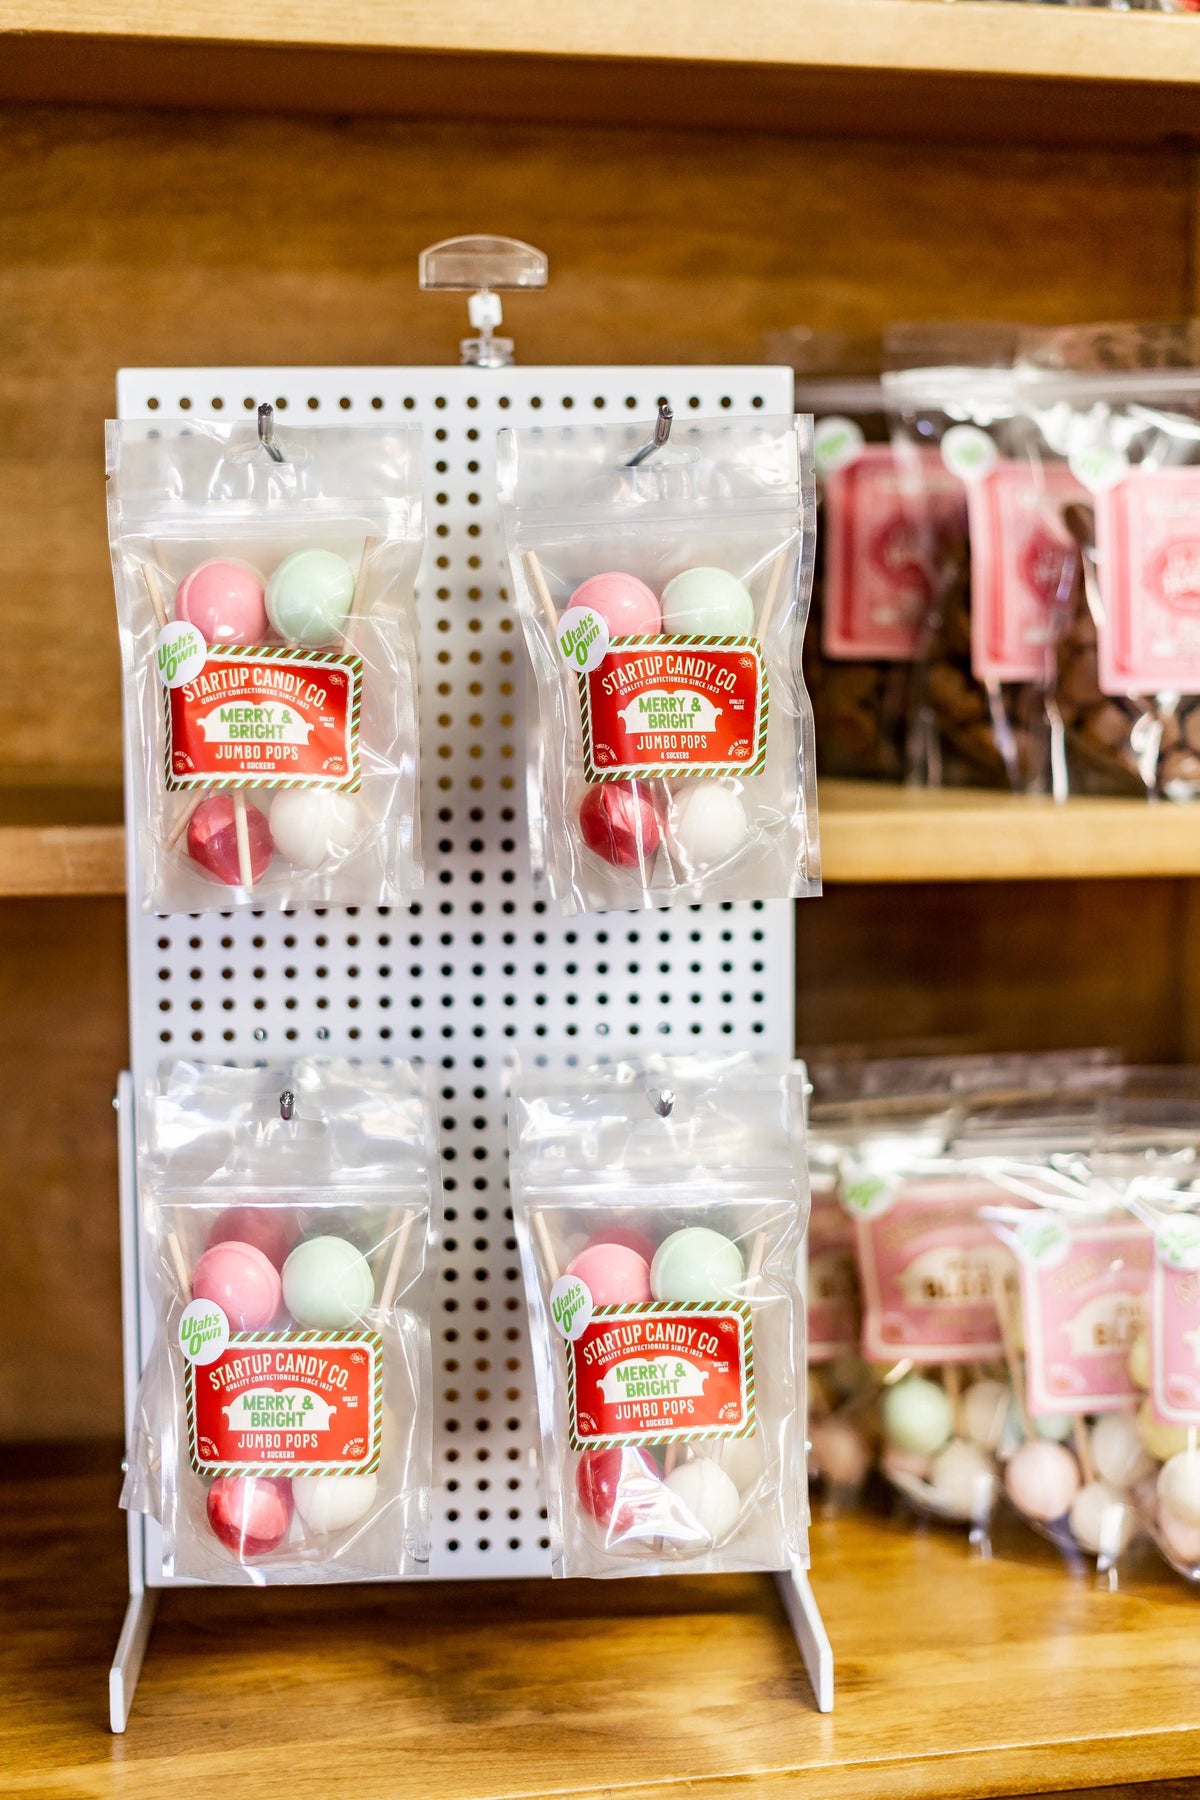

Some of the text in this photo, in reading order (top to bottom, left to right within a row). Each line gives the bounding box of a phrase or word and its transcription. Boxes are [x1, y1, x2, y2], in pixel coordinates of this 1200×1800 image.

[559, 612, 594, 657] Utah's
[158, 632, 194, 670] Utah's
[575, 624, 600, 666] Own
[167, 643, 198, 681] Own
[601, 655, 737, 695] STARTUP CANDY CO.
[182, 667, 327, 710] STARTUP CANDY CO.
[620, 681, 644, 696] QUALITY
[645, 675, 688, 685] CONFECTIONERS
[689, 677, 706, 688] SINCE
[201, 691, 227, 705] QUALITY
[228, 687, 278, 697] CONFECTIONERS
[279, 691, 297, 703] SINCE
[639, 696, 702, 713] MERRY &
[220, 708, 293, 724] MERRY &
[648, 713, 695, 729] BRIGHT
[229, 724, 285, 739] BRIGHT
[637, 734, 708, 750] JUMBO POPS
[215, 744, 298, 760] JUMBO POPS
[666, 751, 690, 760] SUCKERS
[247, 761, 276, 770] SUCKERS
[551, 1283, 581, 1323] Utah's
[563, 1294, 585, 1333] Own
[181, 1313, 220, 1341] Utah's
[189, 1326, 222, 1356] Own
[583, 1322, 719, 1365] STARTUP CANDY CO.
[598, 1350, 621, 1366] QUALITY
[622, 1343, 670, 1355] CONFECTIONERS
[671, 1344, 689, 1354] SINCE
[209, 1352, 349, 1391] STARTUP CANDY CO.
[616, 1362, 687, 1382] MERRY &
[225, 1377, 250, 1392] QUALITY
[251, 1373, 299, 1383] CONFECTIONERS
[300, 1376, 319, 1386] SINCE
[625, 1379, 680, 1398] BRIGHT
[243, 1395, 314, 1411] MERRY &
[615, 1400, 695, 1420] JUMBO POPS
[251, 1411, 306, 1427] BRIGHT
[646, 1417, 674, 1427] SUCKERS
[238, 1433, 281, 1449] JUMBO
[286, 1433, 318, 1448] POPS
[267, 1450, 295, 1459] SUCKERS
